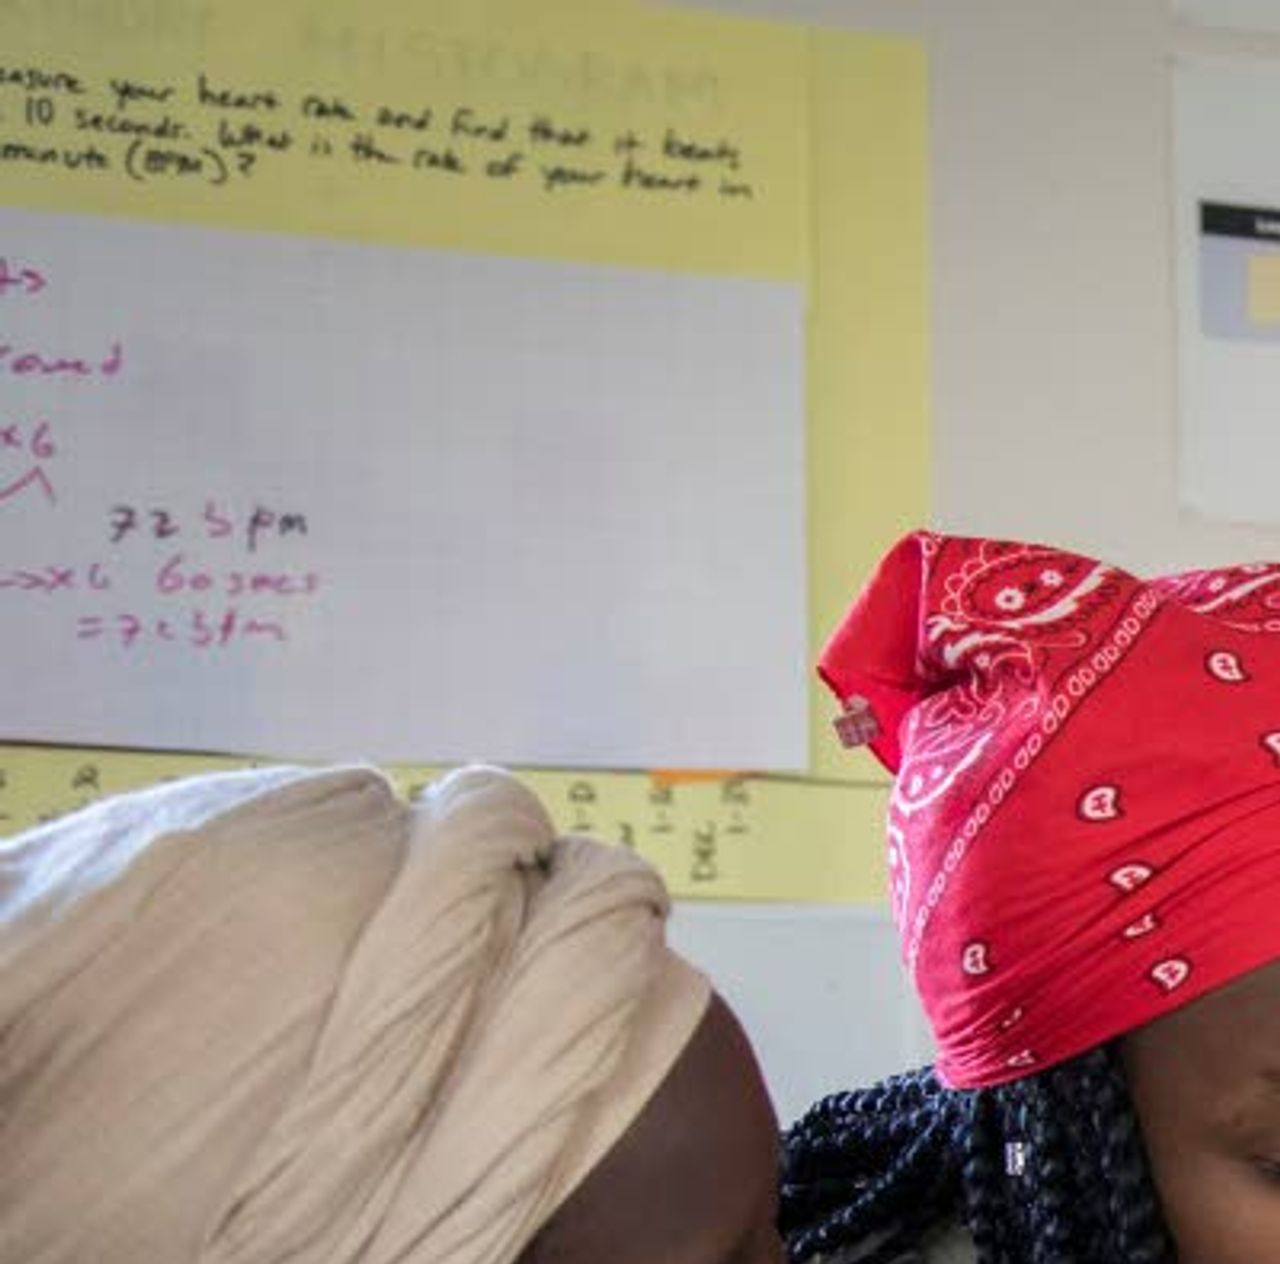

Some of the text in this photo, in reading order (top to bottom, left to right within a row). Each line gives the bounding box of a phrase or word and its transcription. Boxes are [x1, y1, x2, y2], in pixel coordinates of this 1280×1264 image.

[0, 67, 85, 94] easure
[109, 77, 173, 111] your
[197, 72, 277, 108] heart
[451, 106, 508, 141] find
[25, 96, 54, 128] 10
